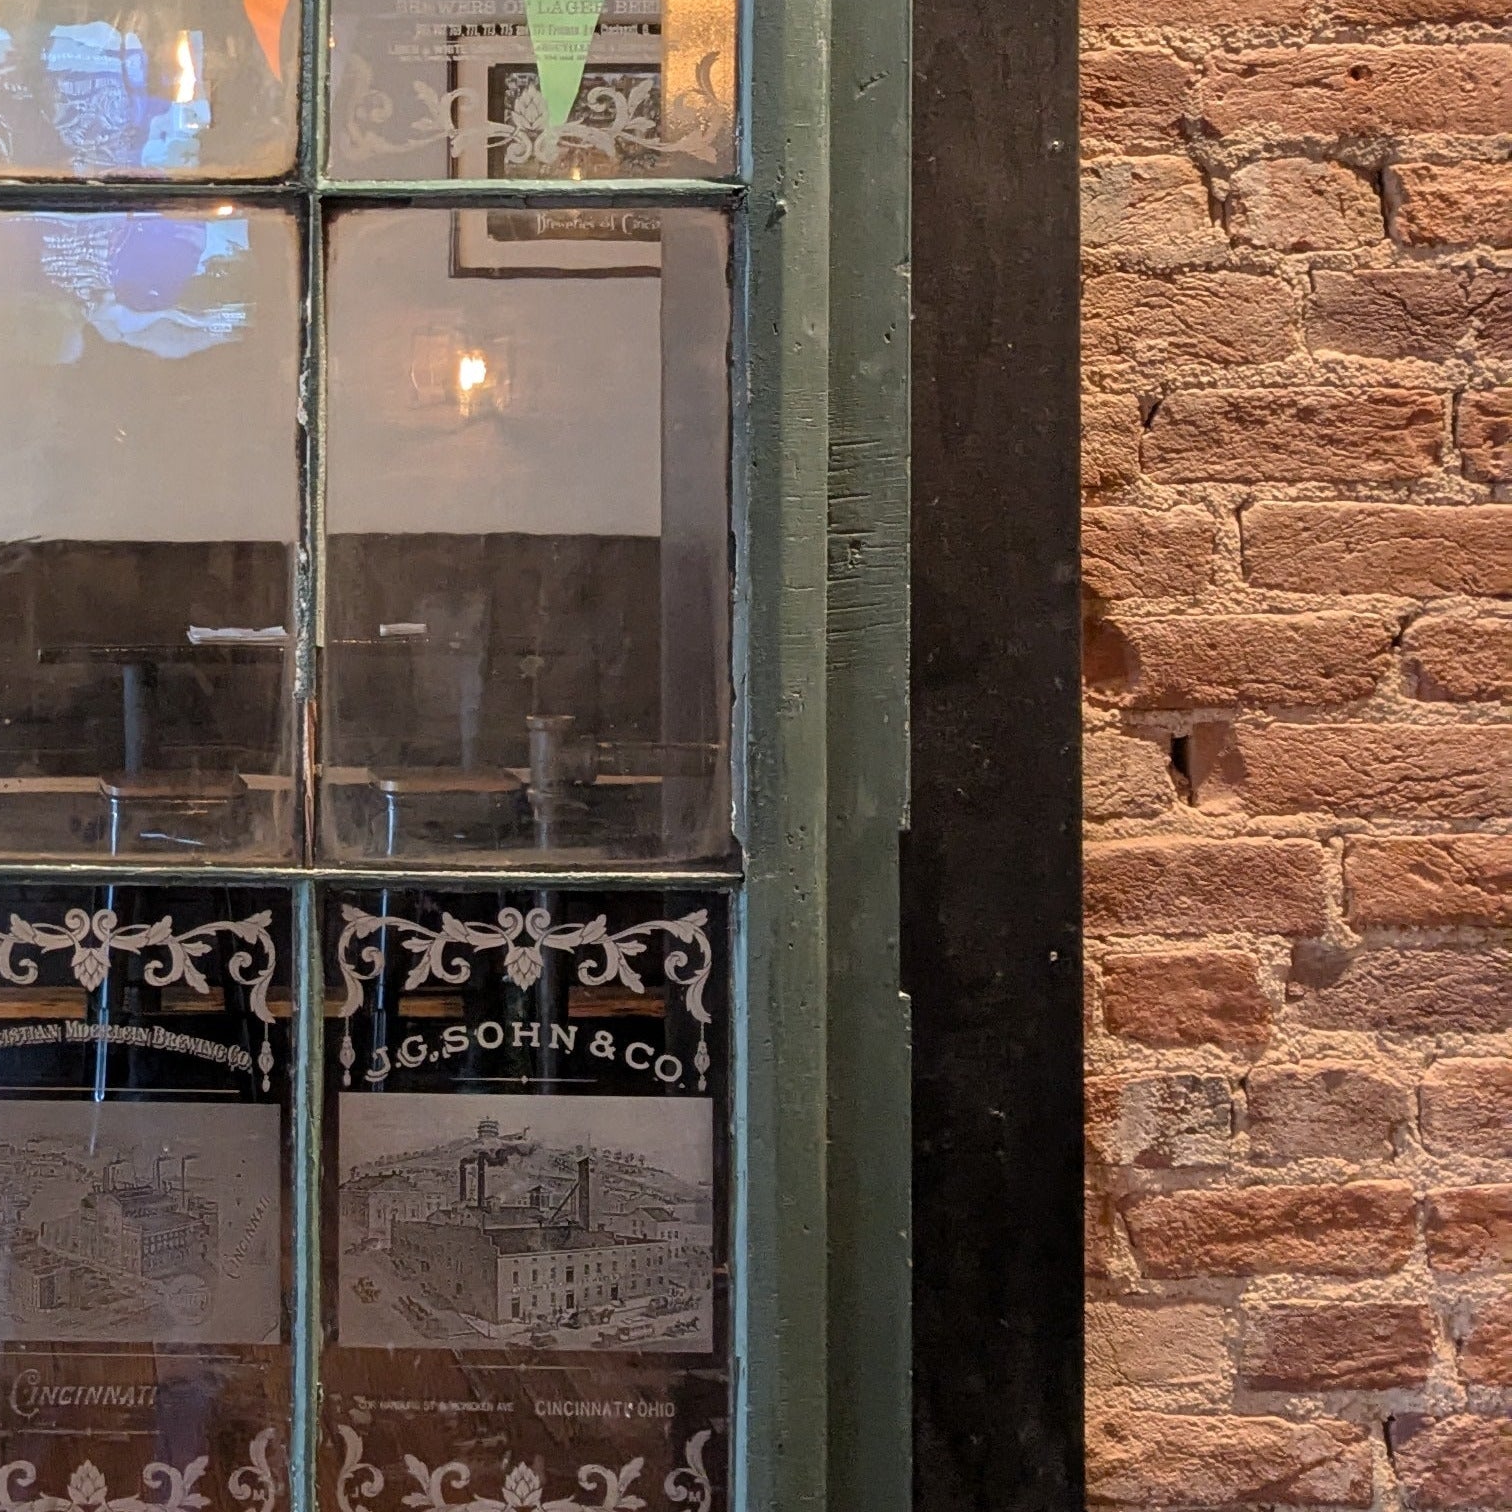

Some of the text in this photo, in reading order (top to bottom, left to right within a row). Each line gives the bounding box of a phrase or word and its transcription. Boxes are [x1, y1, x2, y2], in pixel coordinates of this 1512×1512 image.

[151, 1024, 228, 1063] BREWING
[441, 1020, 579, 1059] SOHN
[589, 1030, 616, 1061] &
[9, 1368, 159, 1418] CINCINNATI
[637, 1399, 676, 1419] OHIO
[252, 1488, 265, 1501] M
